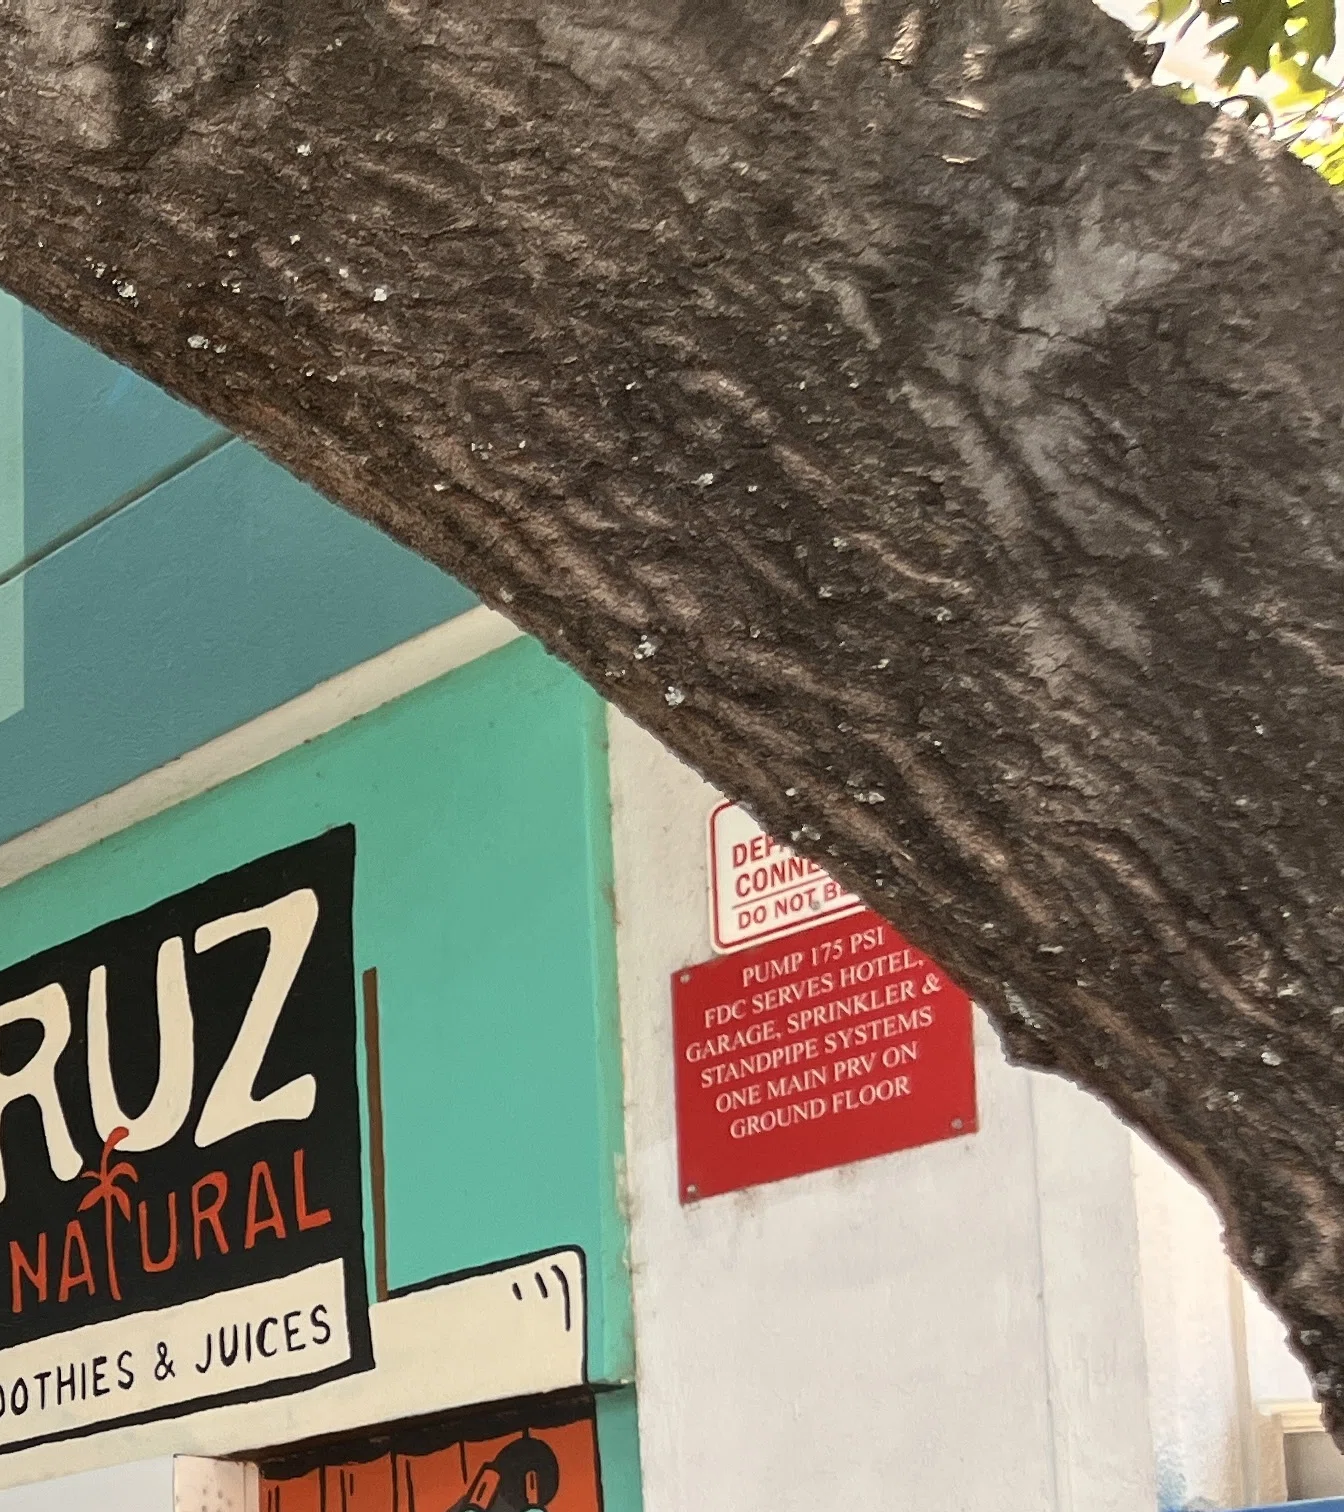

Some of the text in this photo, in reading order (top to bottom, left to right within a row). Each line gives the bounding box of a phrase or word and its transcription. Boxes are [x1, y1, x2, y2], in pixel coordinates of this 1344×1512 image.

[732, 834, 776, 869] DEP
[738, 905, 767, 930] DO
[774, 887, 816, 920] NOT
[742, 926, 885, 987] PUMP 175 PSI
[685, 972, 942, 1063] GARAGE, SPRINKLER &
[704, 999, 746, 1029] FDC
[752, 973, 833, 1015] SERVES
[700, 1005, 934, 1089] STANDPIPE SYSTEMS
[715, 1040, 920, 1114] ONE MAIN PRV ON
[729, 1075, 911, 1139] GROUND FLOOR
[8, 1126, 331, 1314] NATURAL
[154, 1341, 176, 1382] &
[195, 1303, 332, 1374] JUICES
